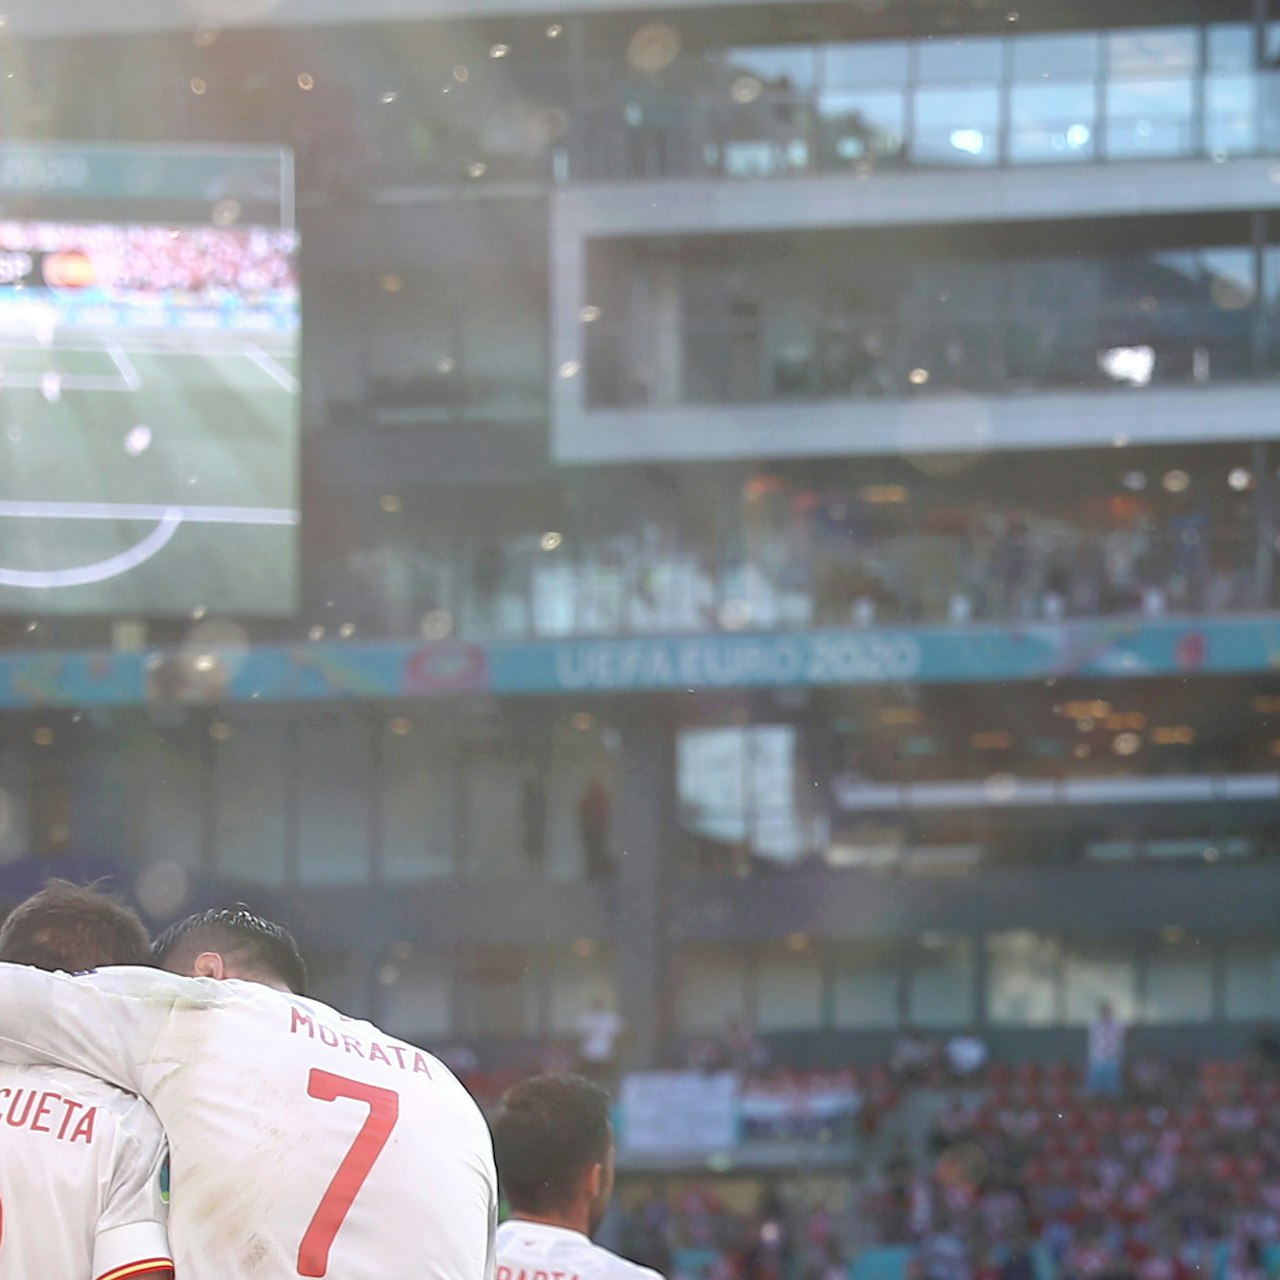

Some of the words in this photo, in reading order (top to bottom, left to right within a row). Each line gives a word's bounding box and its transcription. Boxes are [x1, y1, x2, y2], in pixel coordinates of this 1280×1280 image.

[557, 642, 674, 687] UEFA
[678, 638, 803, 683] EURO
[805, 632, 922, 681] 2020
[290, 1006, 434, 1081] MORATA
[297, 1067, 400, 1278] 7
